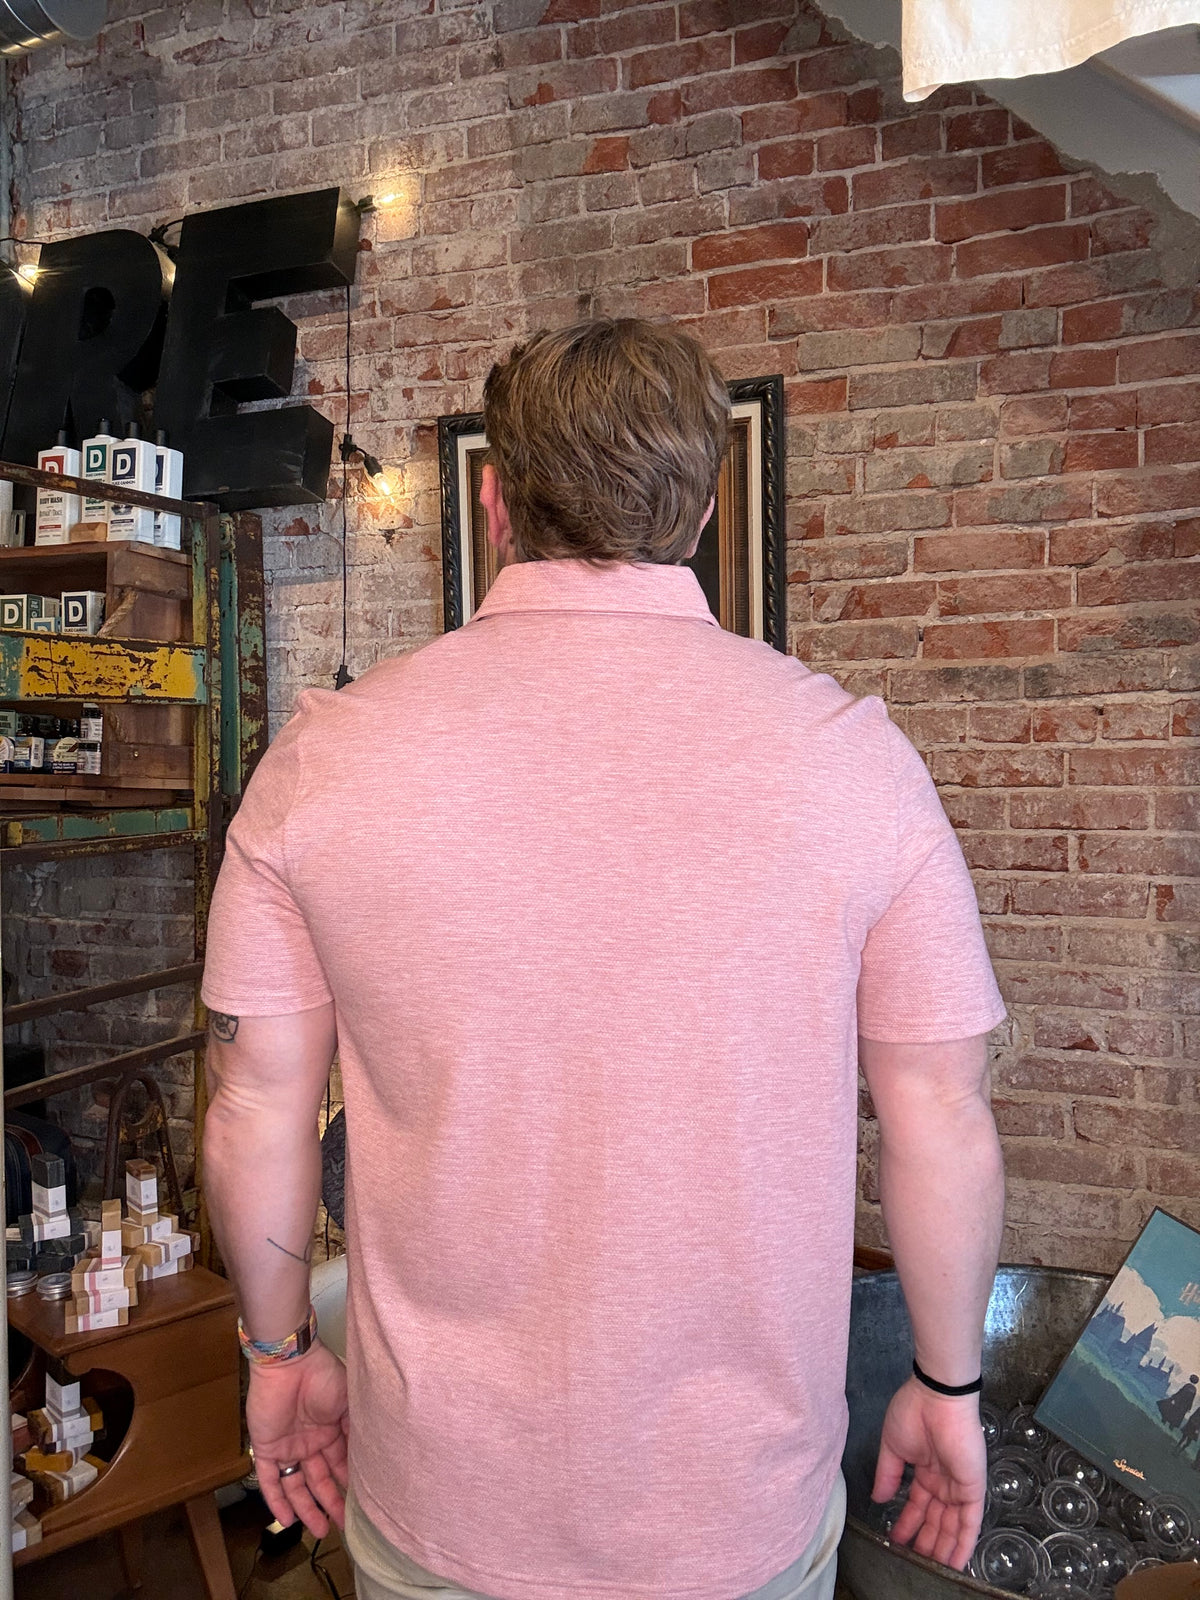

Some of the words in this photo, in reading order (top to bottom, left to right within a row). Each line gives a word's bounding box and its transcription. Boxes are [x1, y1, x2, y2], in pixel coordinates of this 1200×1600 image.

[0, 187, 358, 512] RE
[89, 449, 103, 469] D
[116, 453, 131, 476] D
[3, 603, 19, 625] D
[68, 601, 83, 623] D
